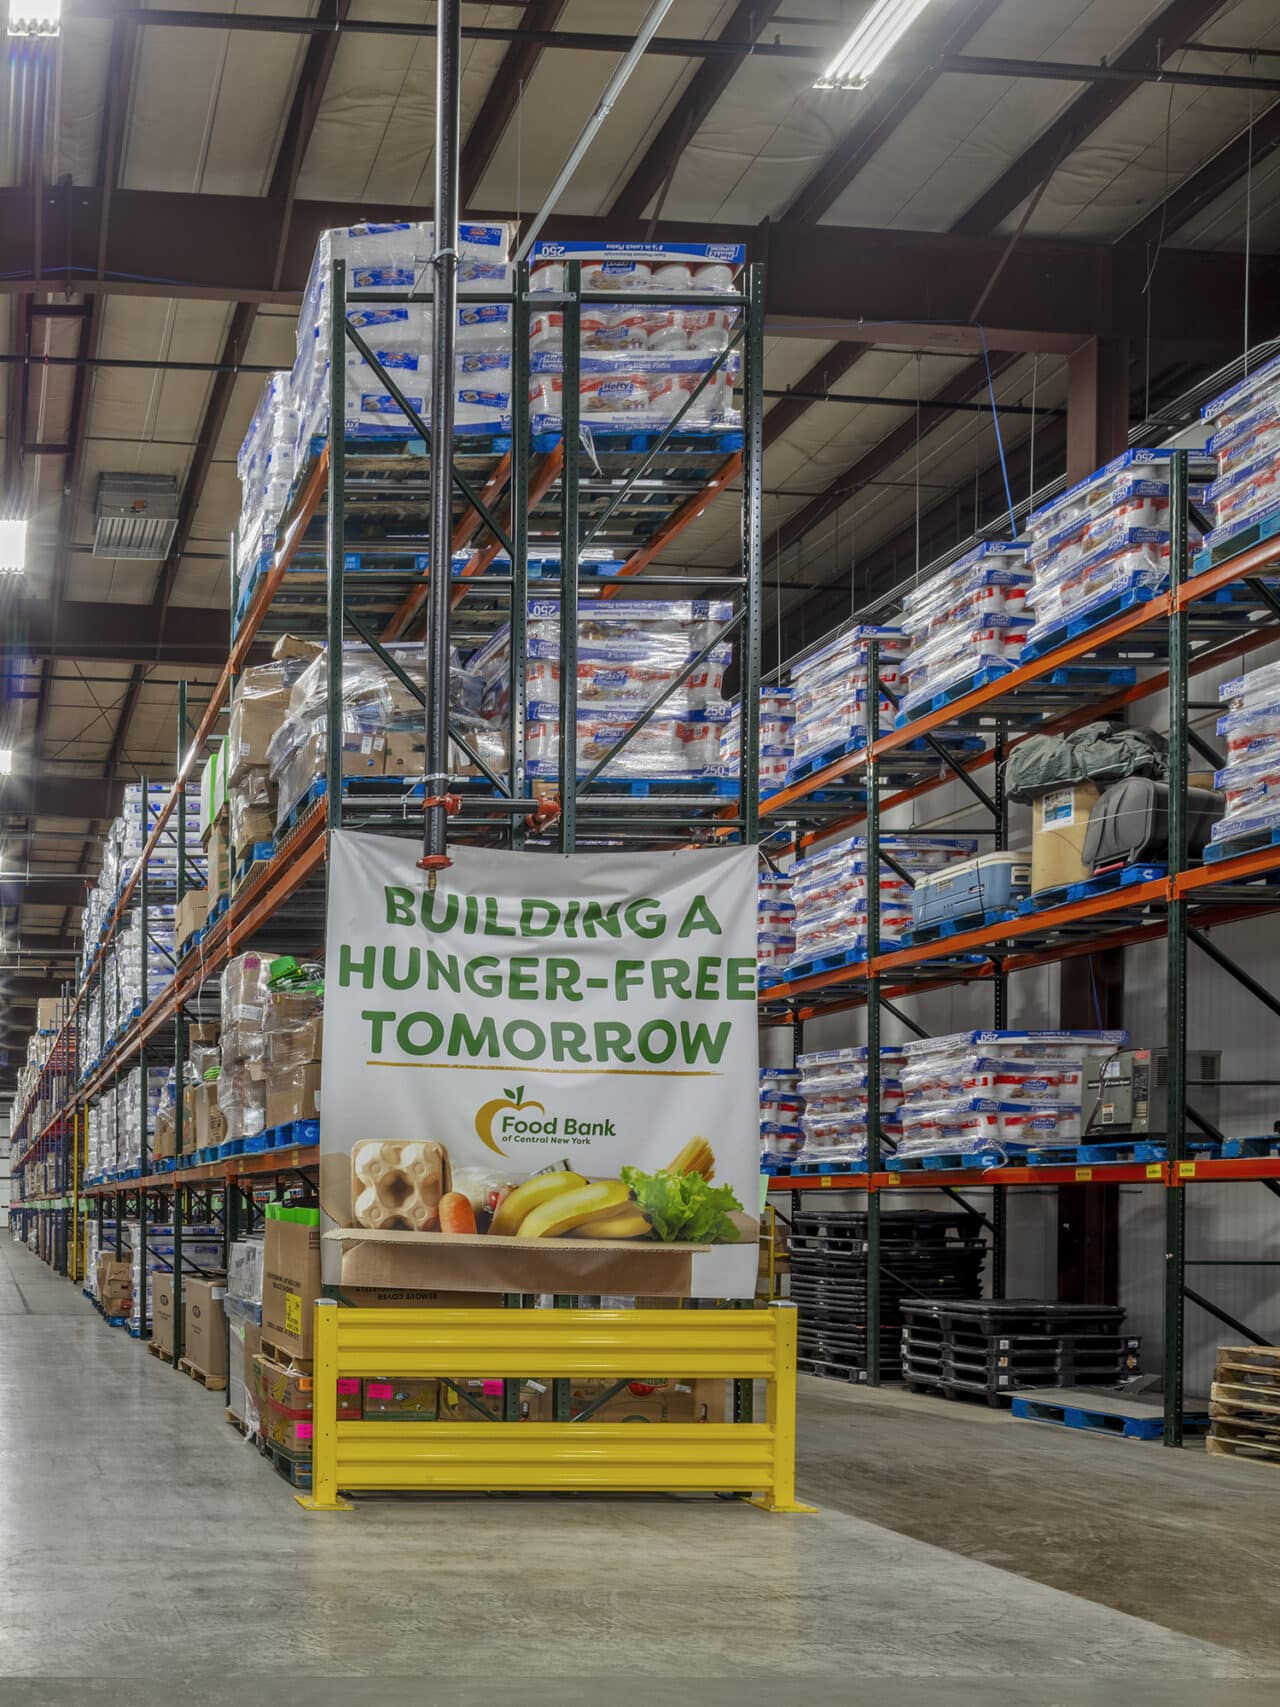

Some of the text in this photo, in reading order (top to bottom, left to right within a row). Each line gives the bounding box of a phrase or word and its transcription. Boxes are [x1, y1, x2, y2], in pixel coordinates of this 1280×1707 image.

[541, 246, 566, 257] 250
[603, 382, 630, 391] Hefty
[1136, 453, 1155, 462] 250
[533, 605, 556, 617] 250
[704, 705, 727, 716] 250
[703, 765, 726, 776] 250
[384, 886, 722, 939] BUILDING A
[339, 944, 757, 1002] HUNGER-FREE
[361, 1010, 732, 1065] TOMORROW
[981, 1033, 999, 1041] 250
[502, 1116, 617, 1137] Food Bank
[514, 1135, 549, 1144] Central
[572, 1137, 592, 1145] York
